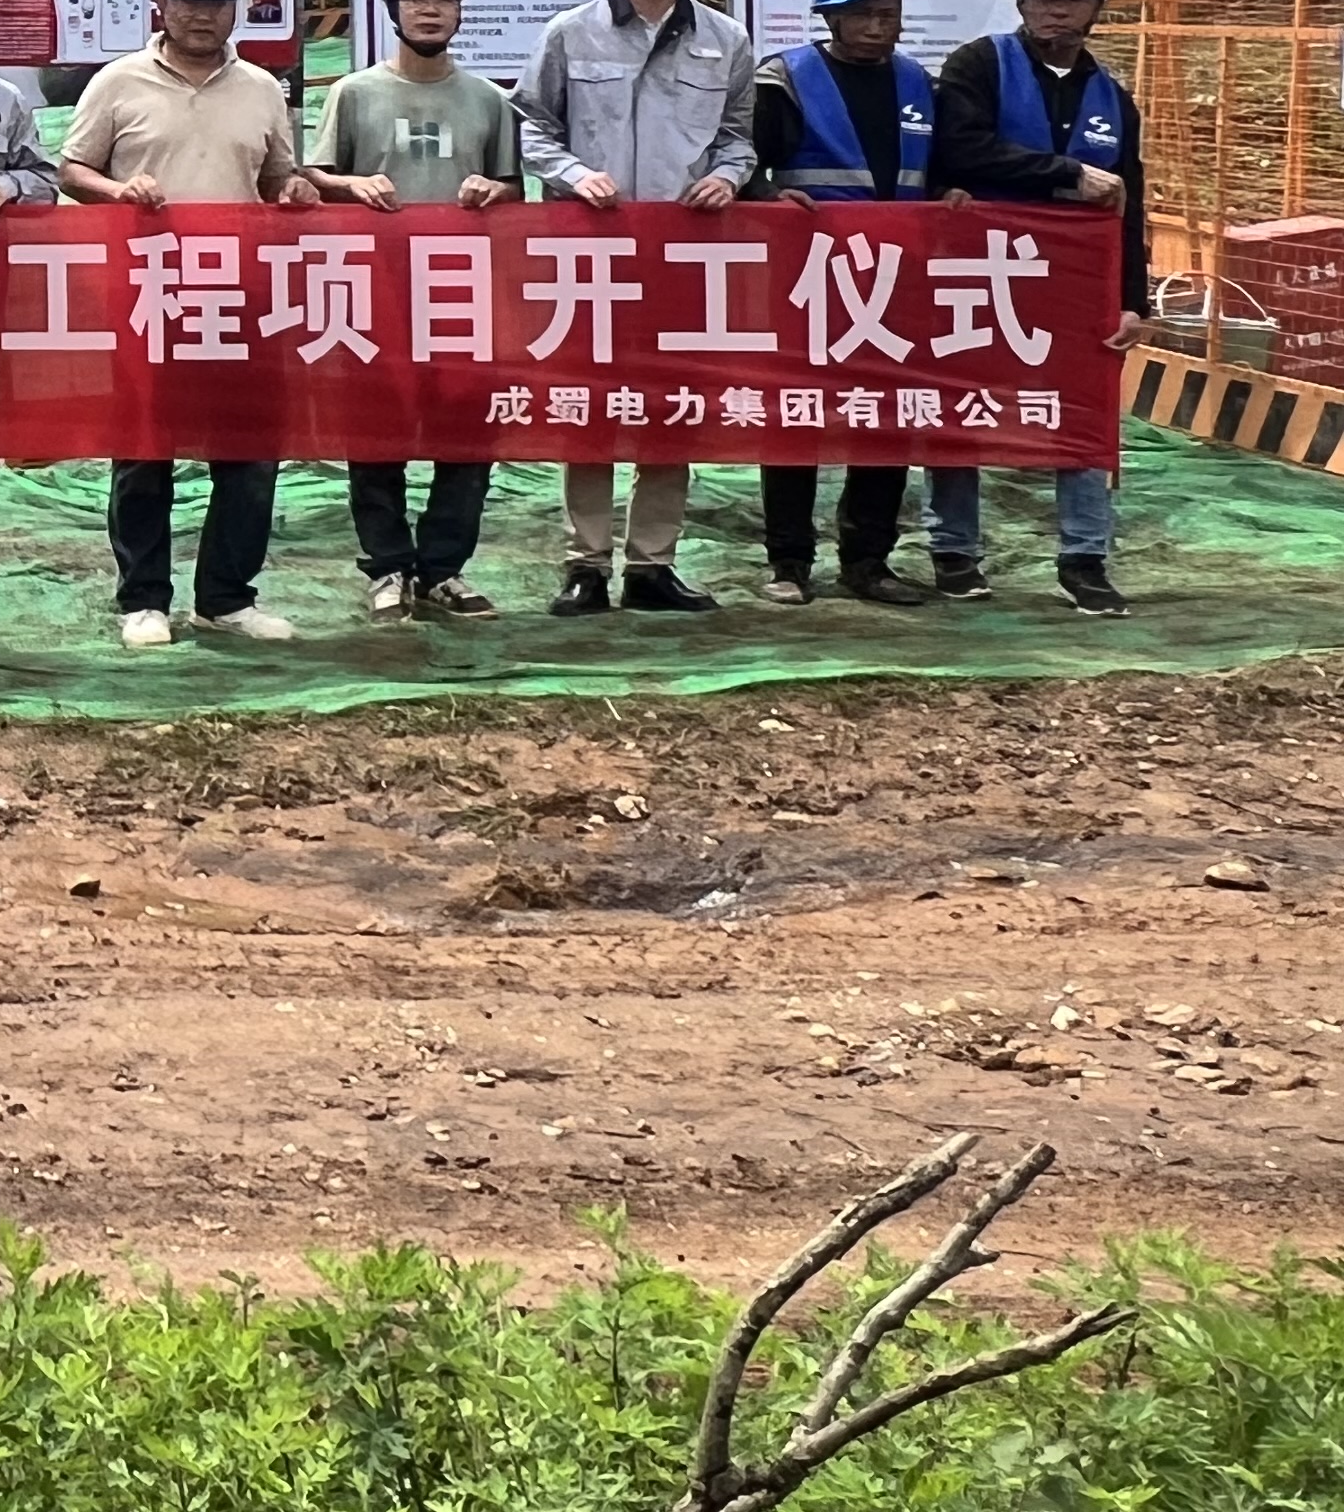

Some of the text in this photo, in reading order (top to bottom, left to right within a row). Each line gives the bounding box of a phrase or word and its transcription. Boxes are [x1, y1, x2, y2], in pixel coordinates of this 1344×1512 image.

[485, 385, 1062, 431] 成蜀电力集团有限公司
